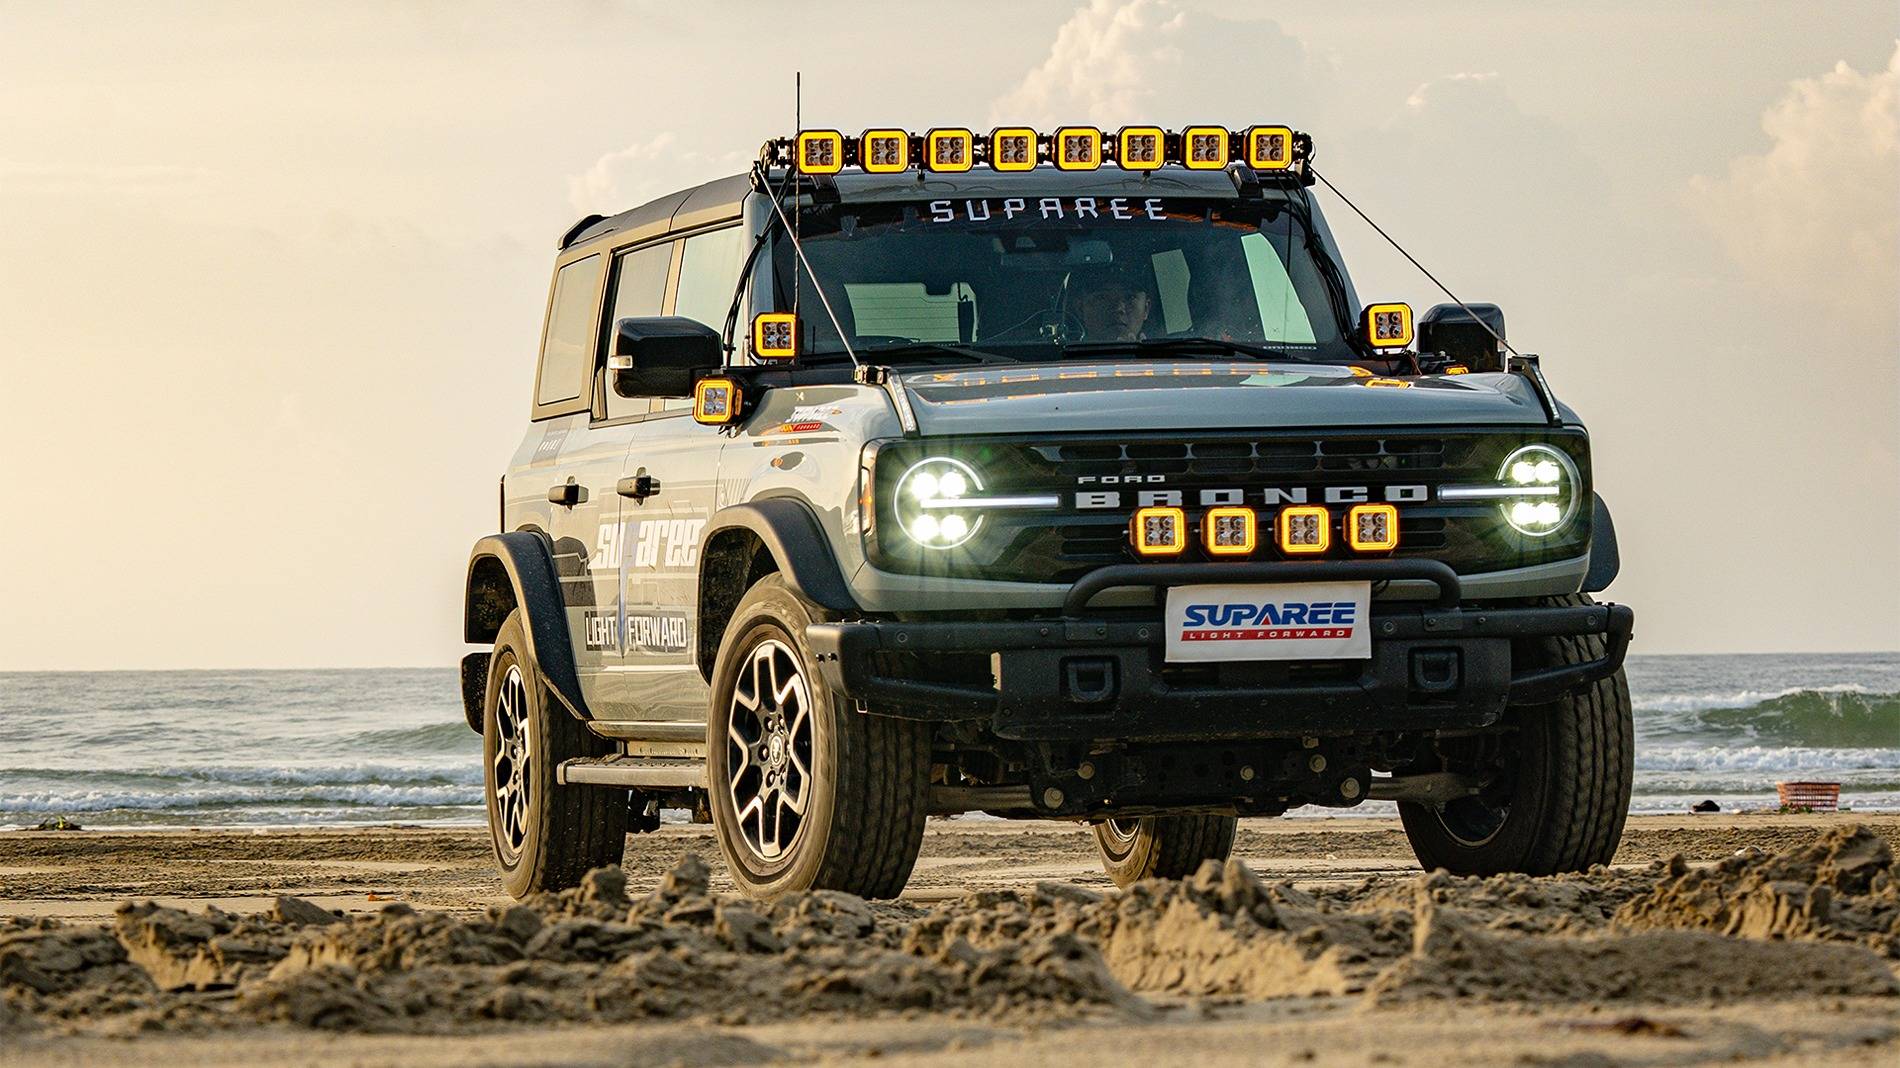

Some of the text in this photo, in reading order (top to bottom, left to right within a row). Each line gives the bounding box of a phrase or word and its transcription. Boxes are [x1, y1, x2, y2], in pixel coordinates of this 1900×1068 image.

[930, 197, 1168, 222] SUPAREE
[1077, 474, 1166, 485] FORD
[1075, 485, 1428, 508] BRONCO
[587, 519, 707, 569] suaree
[1183, 602, 1357, 627] SUPAREE
[585, 616, 687, 647] LIGHT FORWARD
[1188, 629, 1346, 640] LIGHT FORWARD
